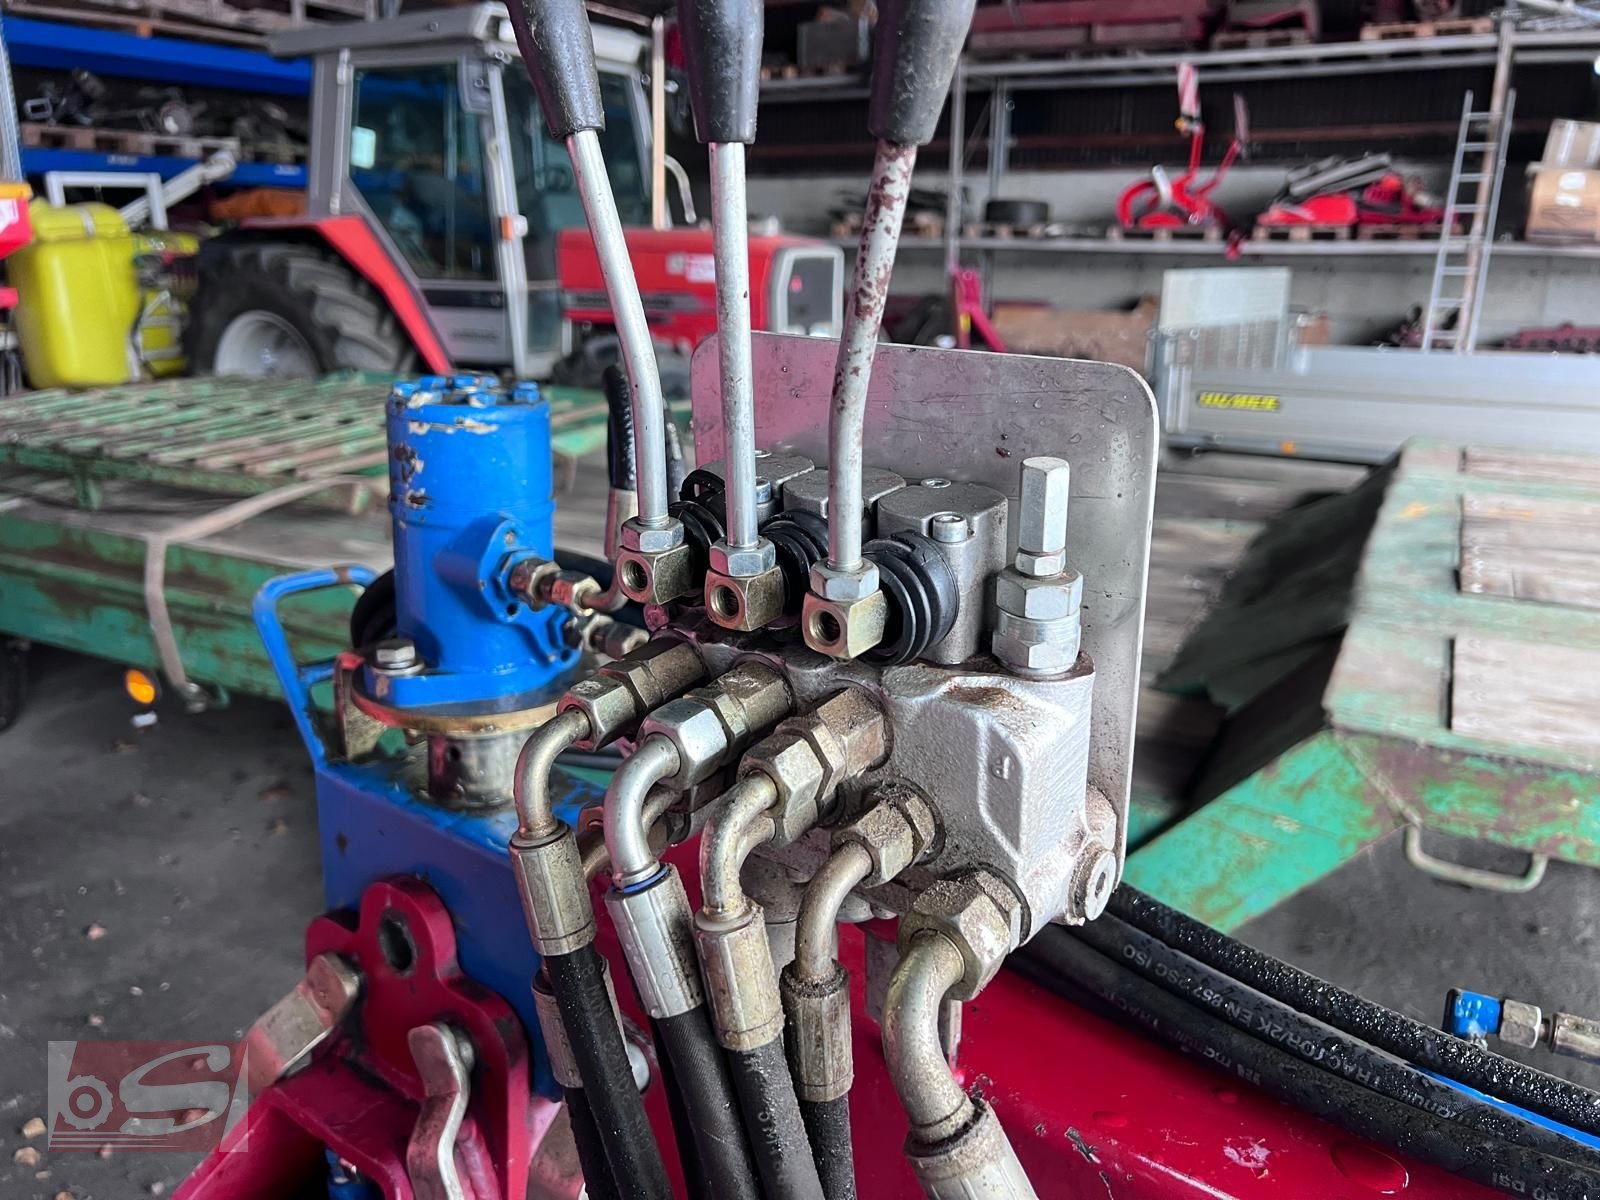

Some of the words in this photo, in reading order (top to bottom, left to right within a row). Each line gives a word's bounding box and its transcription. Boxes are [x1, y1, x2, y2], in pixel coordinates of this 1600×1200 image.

[1114, 938, 1154, 969] ISO
[1190, 981, 1225, 1009] 857
[1222, 998, 1256, 1026] EN
